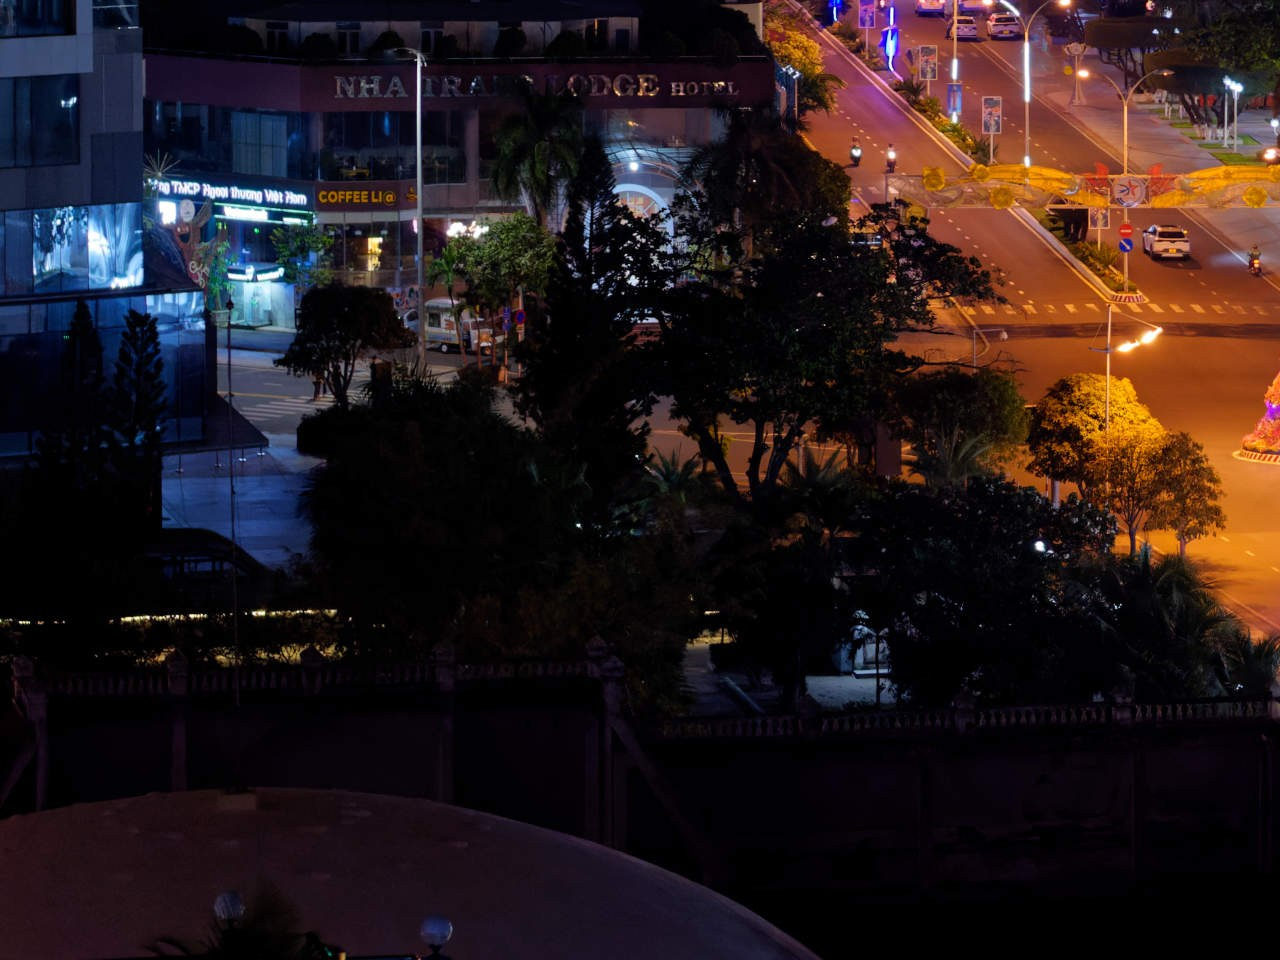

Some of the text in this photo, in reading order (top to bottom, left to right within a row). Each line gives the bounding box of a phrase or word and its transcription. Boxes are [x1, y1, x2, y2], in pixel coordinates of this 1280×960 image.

[334, 75, 408, 98] NHA
[546, 73, 661, 98] LODGE
[669, 81, 740, 96] HOTEL
[171, 180, 200, 196] TMCP
[318, 190, 369, 204] COFFEE
